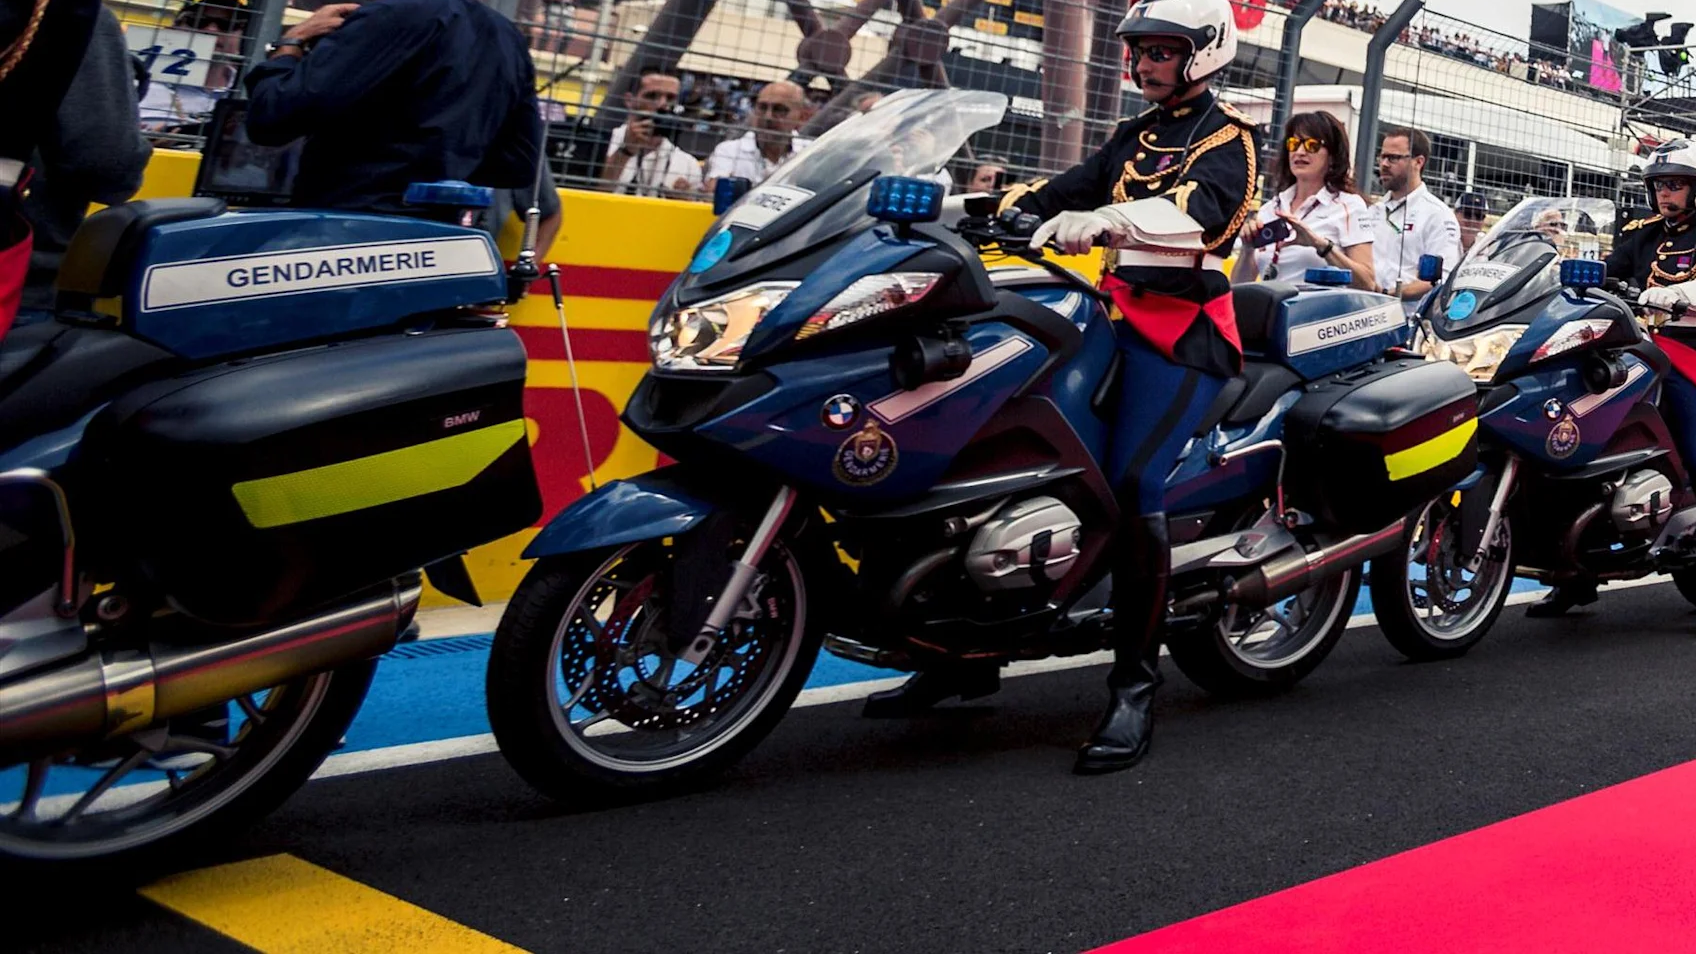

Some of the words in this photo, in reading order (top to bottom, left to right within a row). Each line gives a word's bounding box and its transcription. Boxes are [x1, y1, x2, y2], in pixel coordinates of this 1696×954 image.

[137, 45, 197, 76] 12
[226, 250, 437, 289] GENDARMERIE
[1317, 312, 1388, 340] GENDARMERIE
[444, 409, 481, 428] BMW
